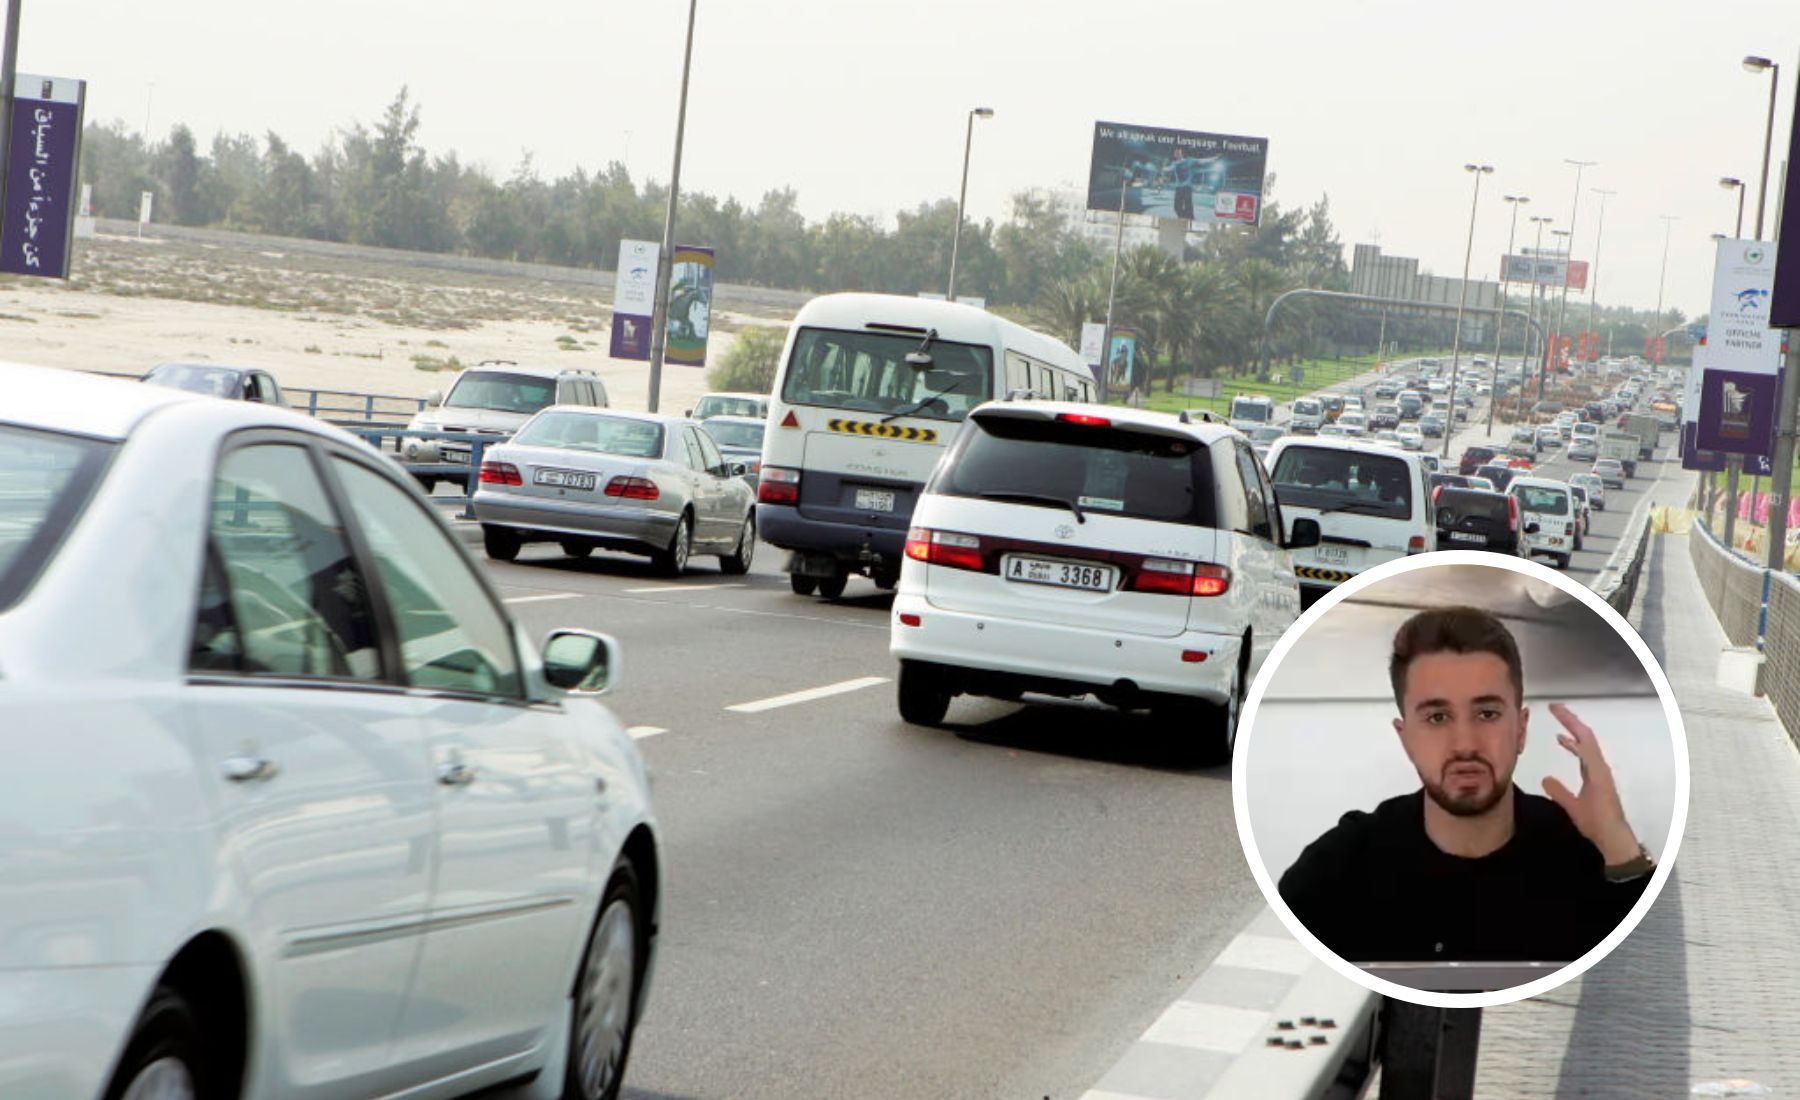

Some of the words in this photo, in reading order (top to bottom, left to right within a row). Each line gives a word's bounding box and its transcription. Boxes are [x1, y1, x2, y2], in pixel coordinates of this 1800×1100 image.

[31, 108, 52, 165] السباق
[1100, 127, 1113, 138] We
[1130, 131, 1156, 144] speak
[1158, 135, 1175, 145] one
[29, 168, 46, 191] من
[22, 243, 40, 268] كن
[1725, 339, 1763, 350] PARTNER
[1013, 560, 1023, 576] A
[1061, 566, 1102, 587] 3368
